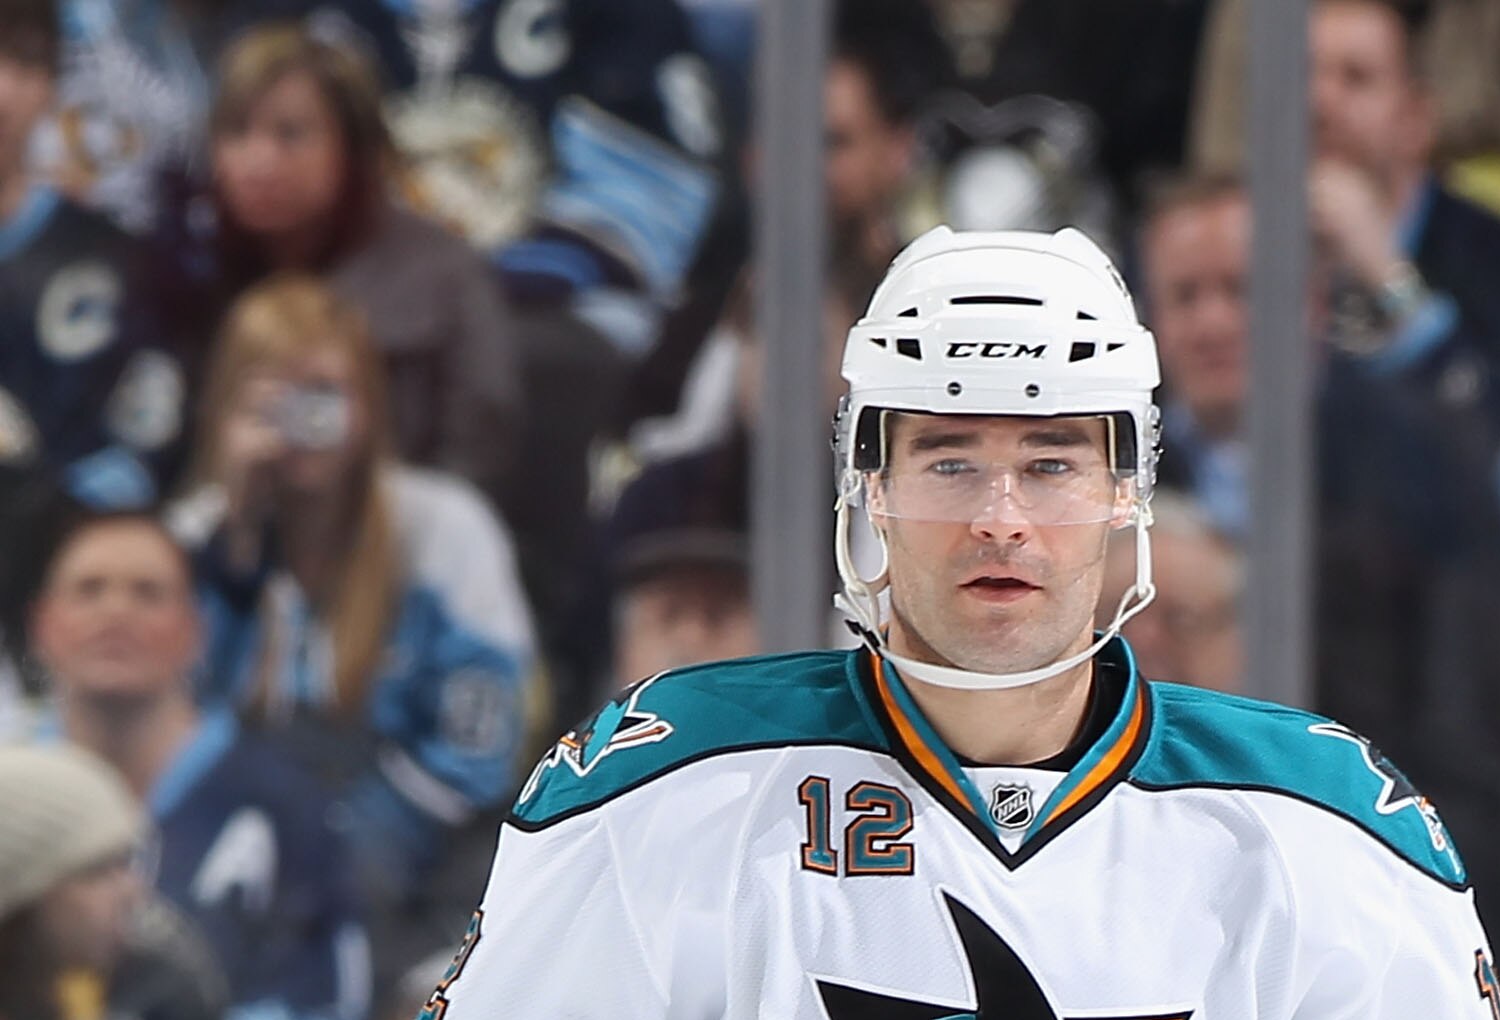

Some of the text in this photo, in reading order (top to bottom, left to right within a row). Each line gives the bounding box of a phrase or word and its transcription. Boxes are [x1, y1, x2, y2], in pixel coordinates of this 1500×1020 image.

[946, 342, 1048, 360] CCM
[998, 794, 1027, 821] NHL
[798, 775, 915, 878] 12
